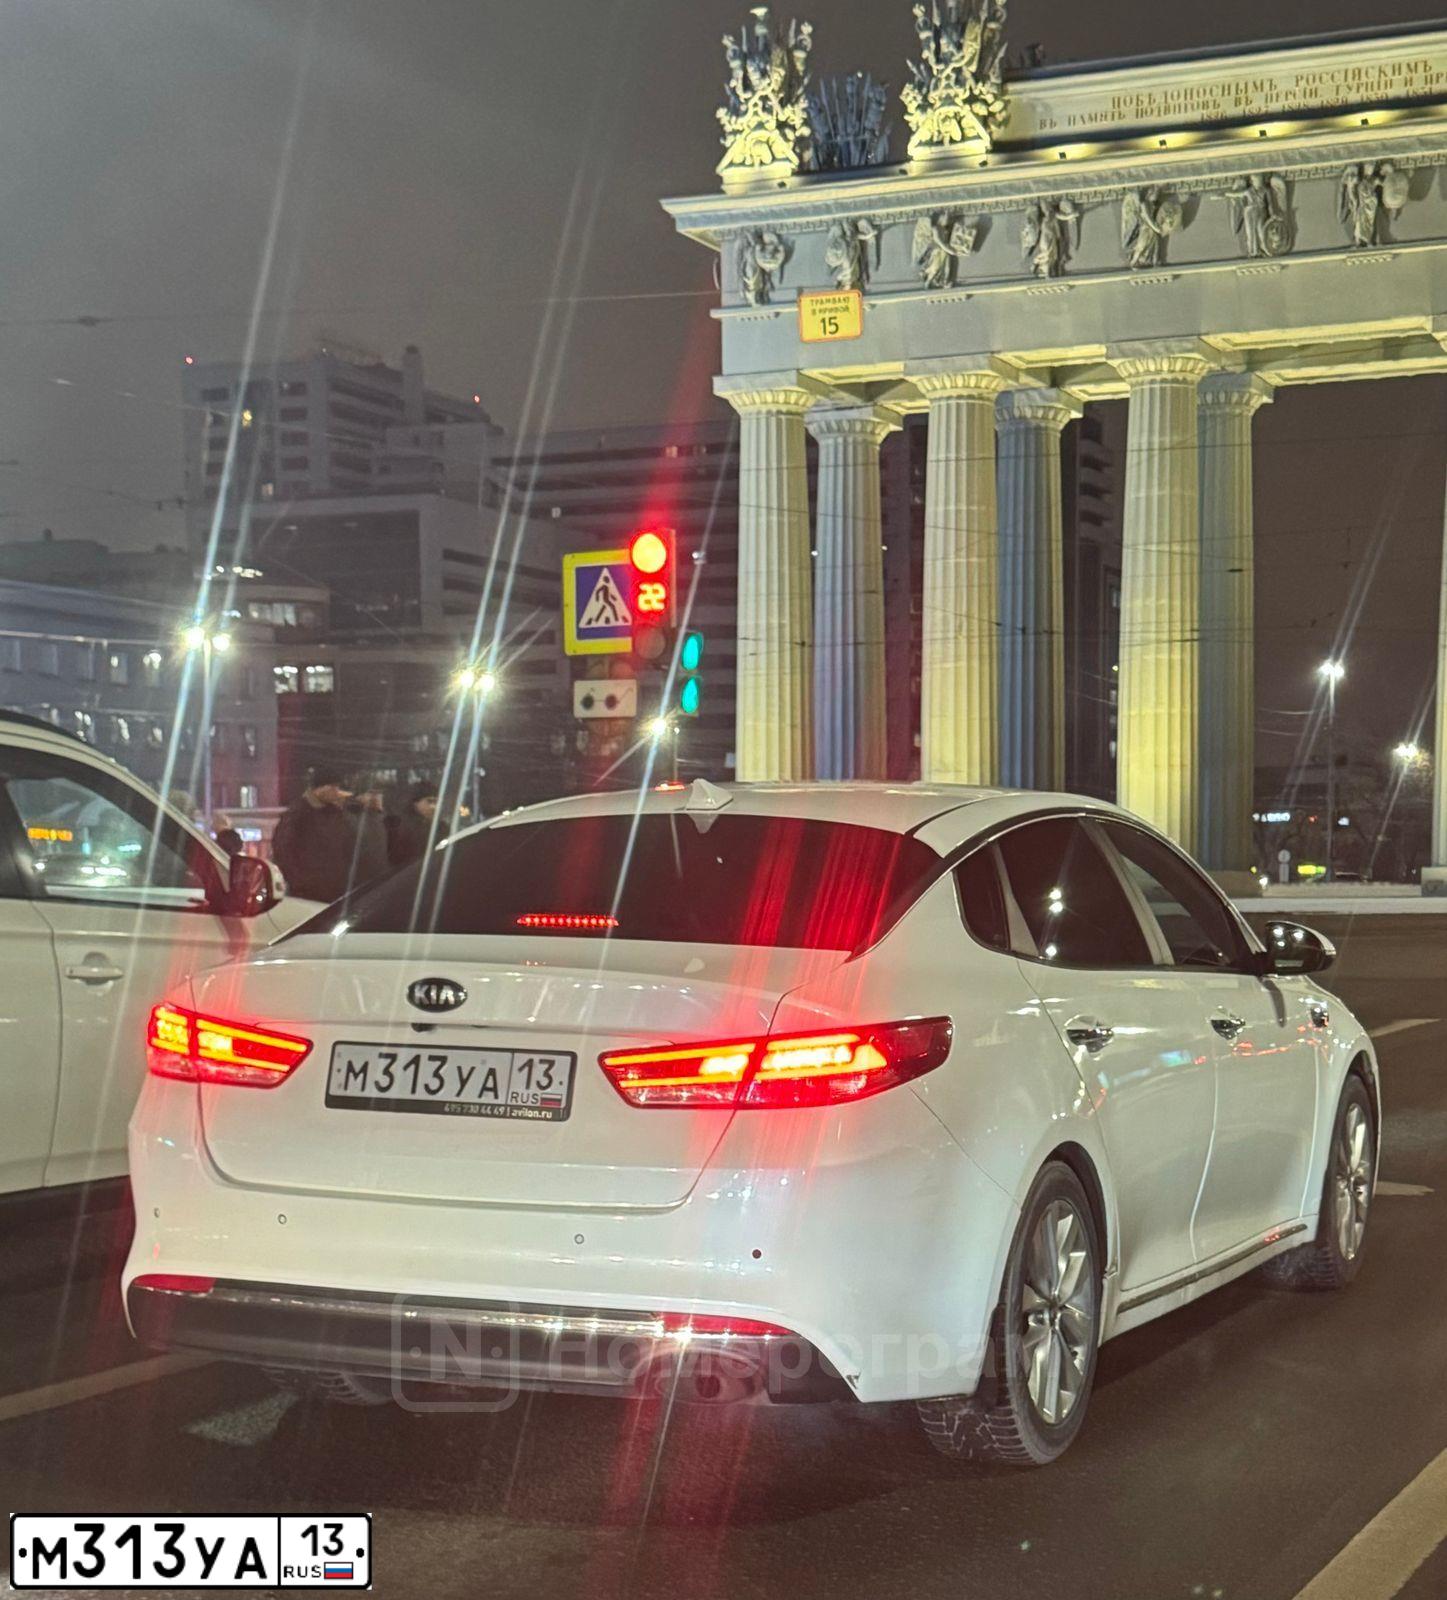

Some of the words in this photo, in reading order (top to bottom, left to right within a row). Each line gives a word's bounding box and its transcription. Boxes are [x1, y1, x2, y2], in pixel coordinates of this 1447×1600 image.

[821, 316, 839, 335] 15
[414, 984, 455, 1005] KIA
[343, 1052, 500, 1100] М313УА
[518, 1058, 556, 1091] 13
[510, 1091, 540, 1105] RUS
[511, 1107, 553, 1119] avilon.ru
